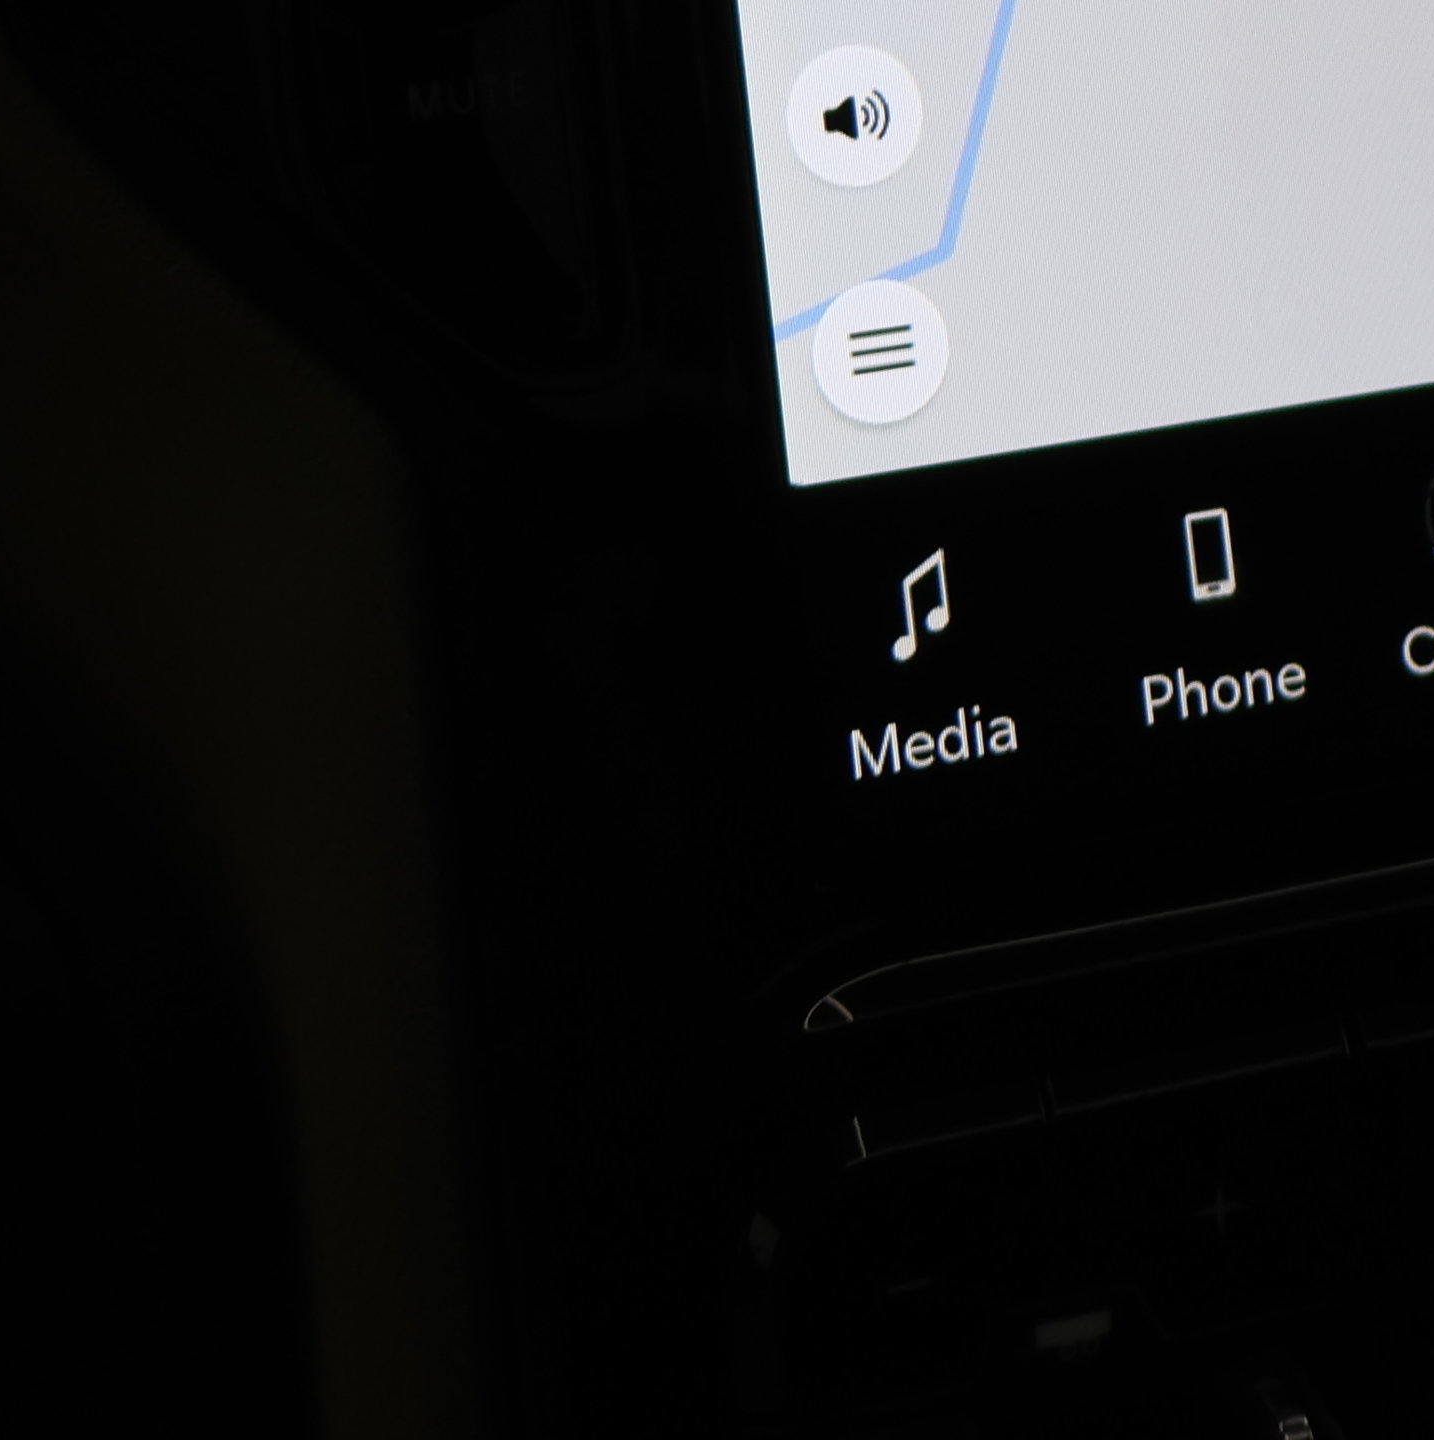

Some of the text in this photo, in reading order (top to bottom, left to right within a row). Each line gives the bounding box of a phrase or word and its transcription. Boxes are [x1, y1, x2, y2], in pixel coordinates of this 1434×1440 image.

[407, 70, 529, 123] MUTE
[1142, 663, 1306, 726] Phone
[850, 704, 1018, 780] Media
